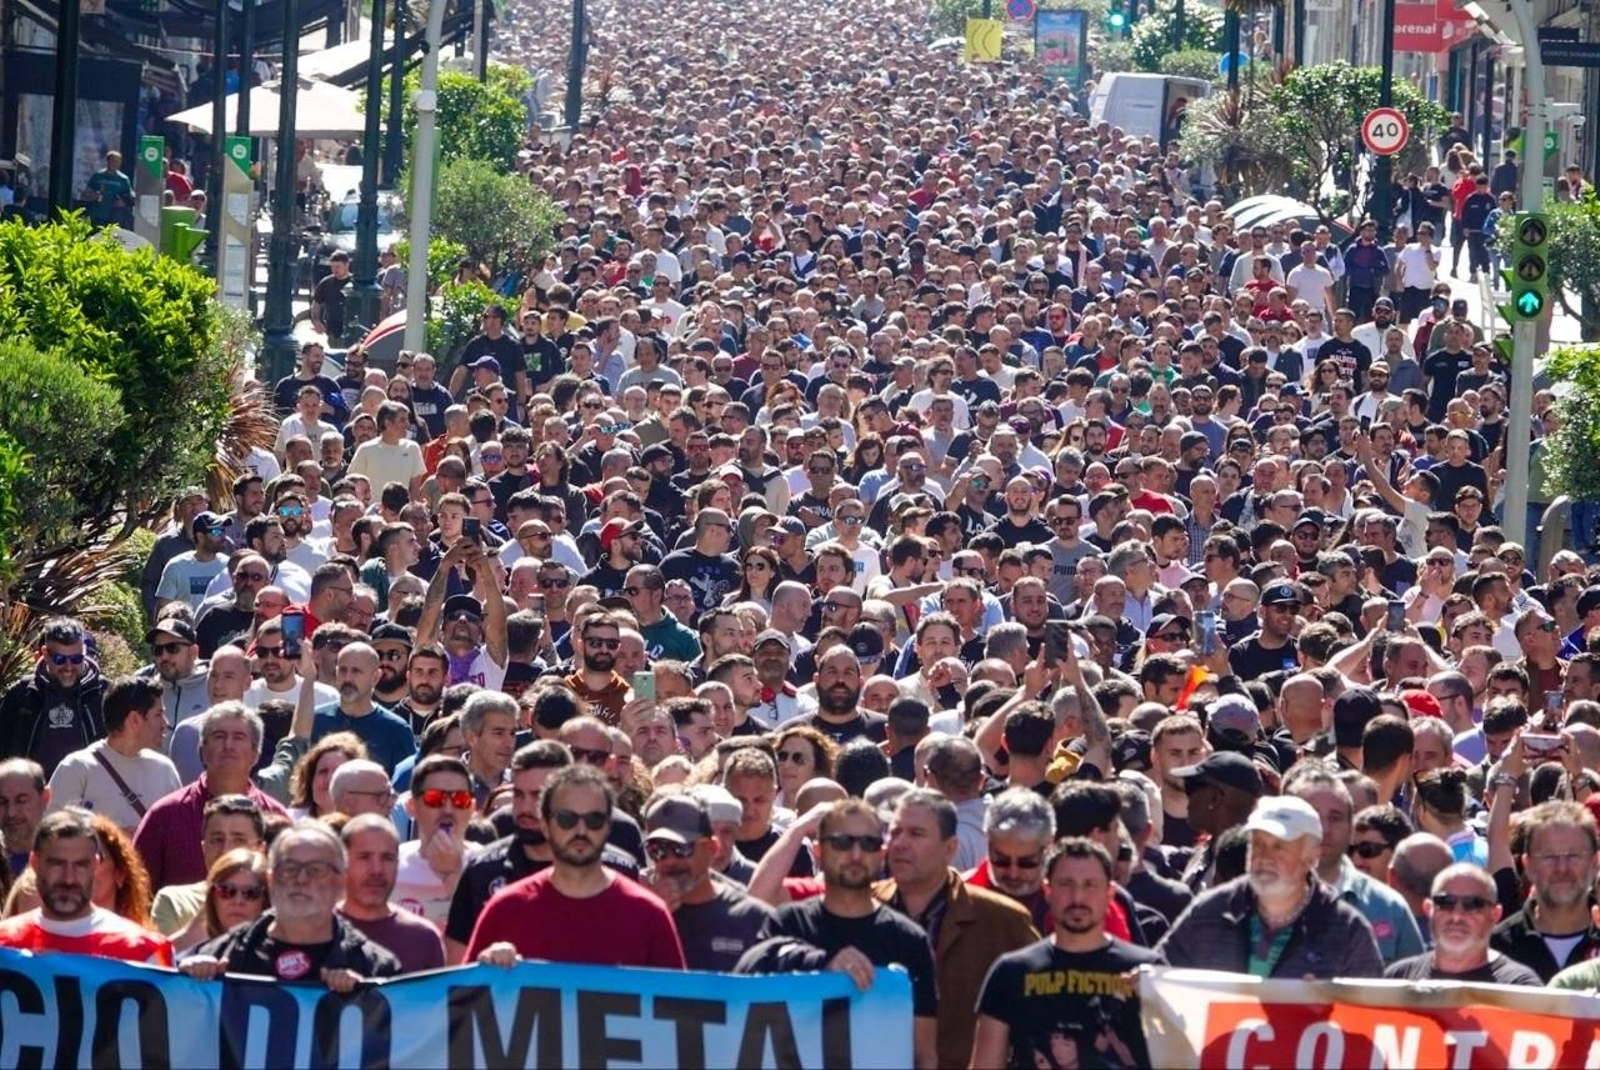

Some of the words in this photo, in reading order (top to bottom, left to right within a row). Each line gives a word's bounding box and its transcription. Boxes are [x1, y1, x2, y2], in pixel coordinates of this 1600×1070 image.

[1372, 122, 1398, 138] 40
[1024, 971, 1065, 996] PULP
[219, 980, 391, 1069] DO
